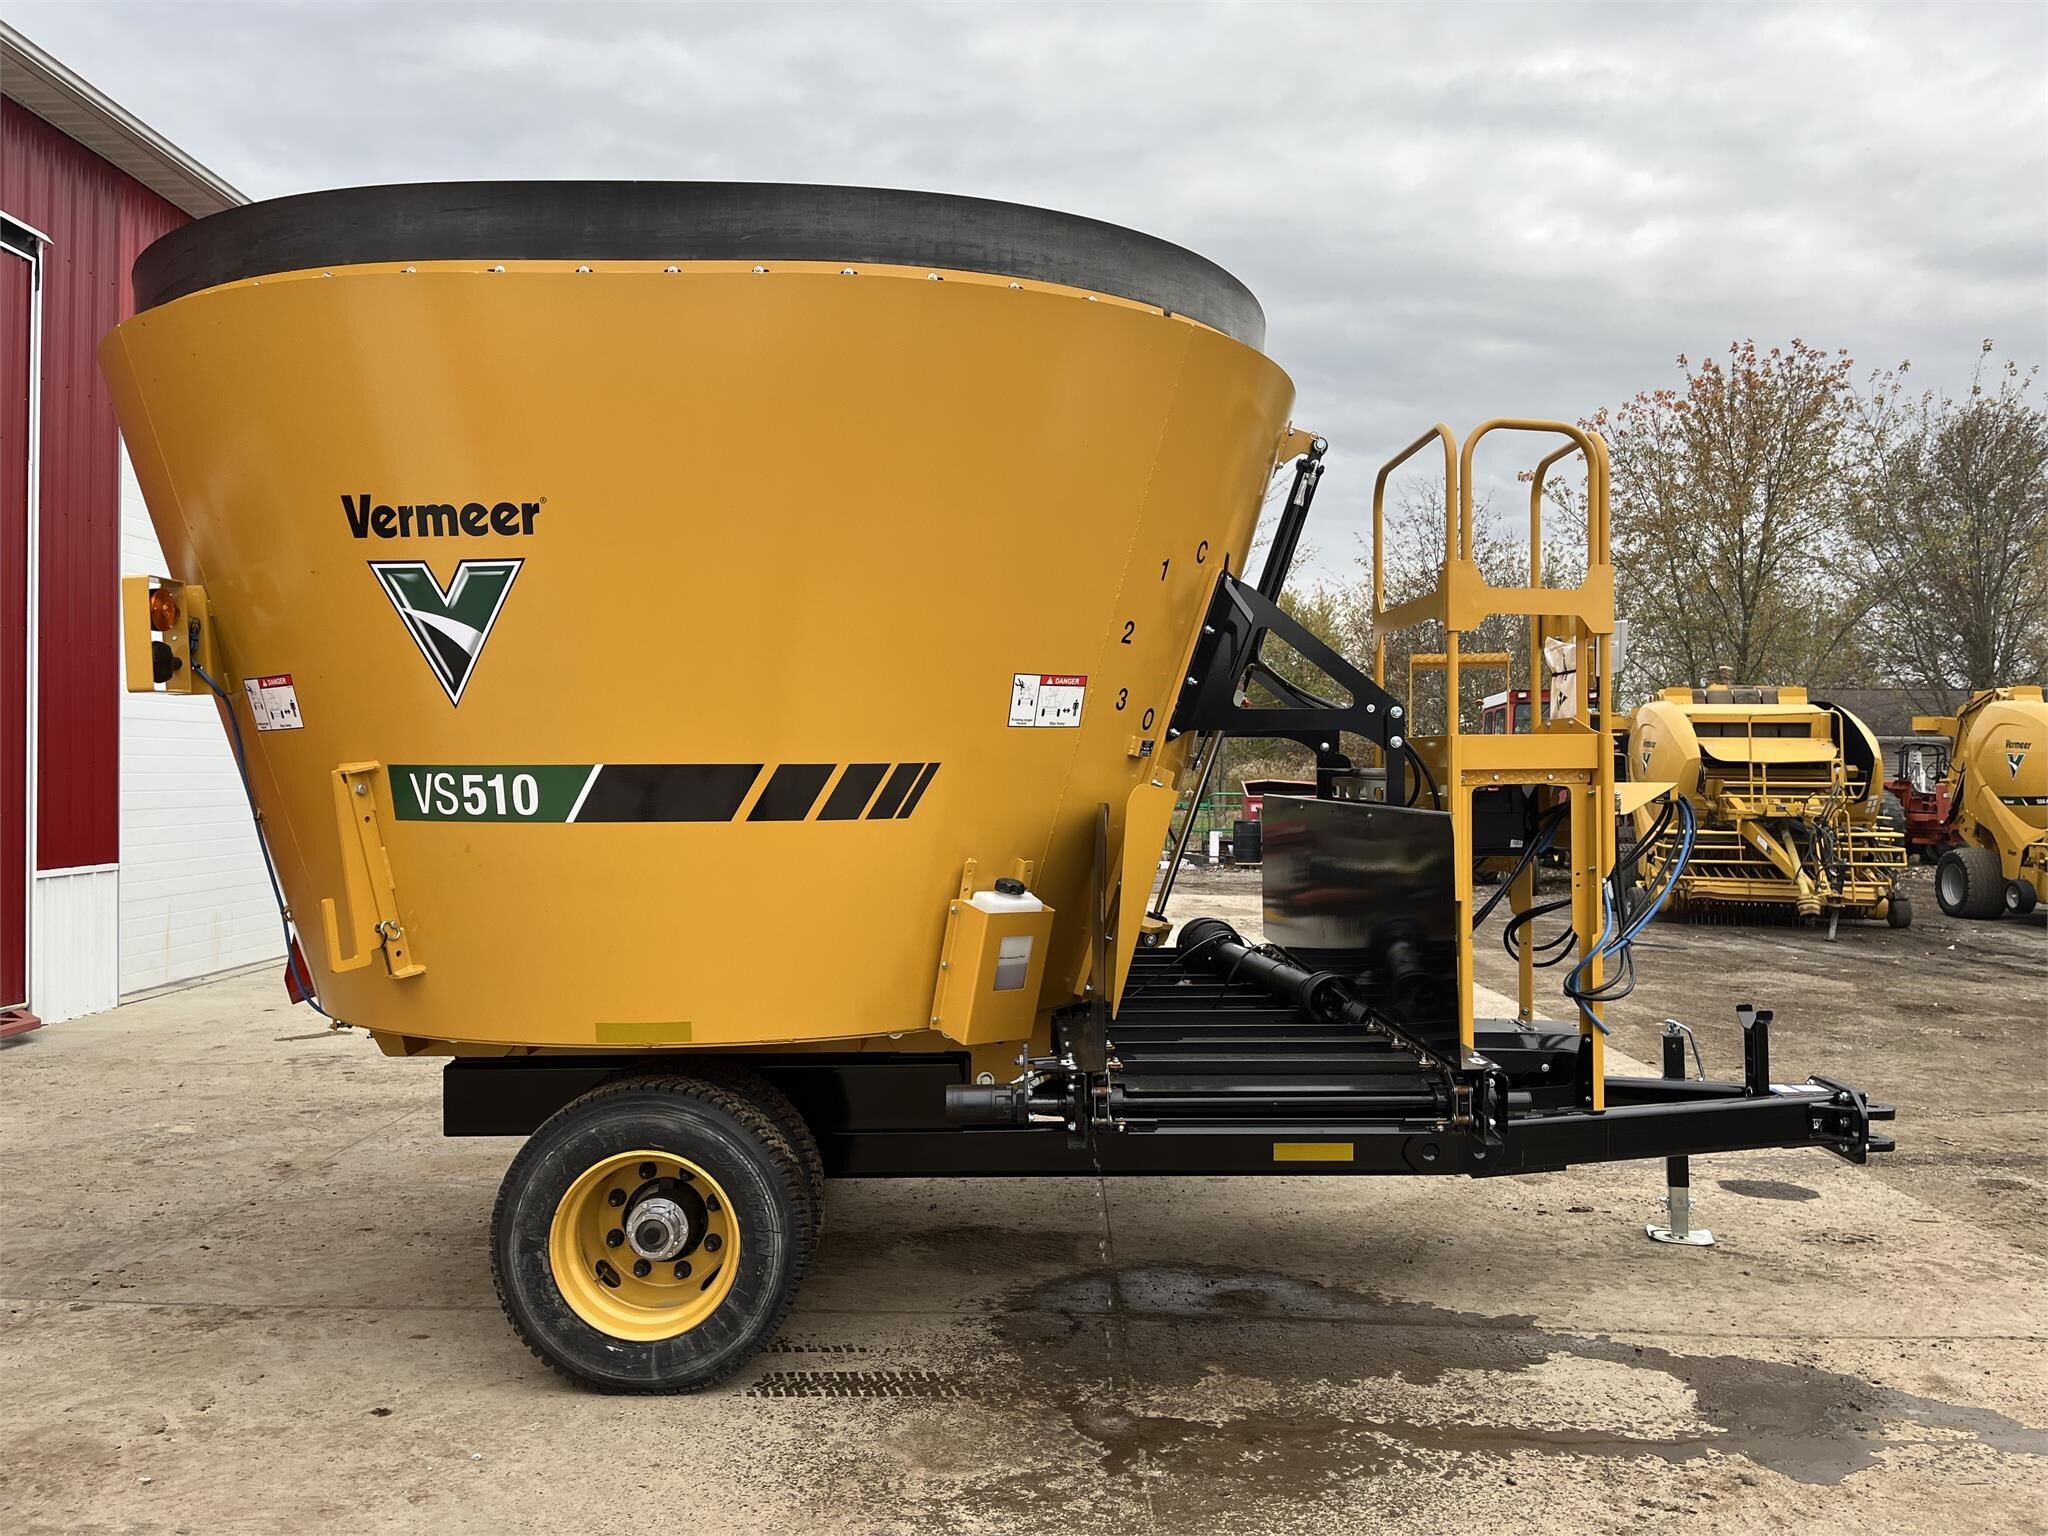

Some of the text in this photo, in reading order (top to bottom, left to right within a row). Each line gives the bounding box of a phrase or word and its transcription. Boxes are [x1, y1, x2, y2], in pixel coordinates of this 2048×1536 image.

[340, 494, 540, 538] Vermeer
[1196, 540, 1209, 564] C
[1161, 558, 1171, 581] 1
[1120, 620, 1135, 645] 2
[1054, 677, 1080, 685] DANGER
[1115, 687, 1129, 711] 3
[409, 772, 539, 816] VS510
